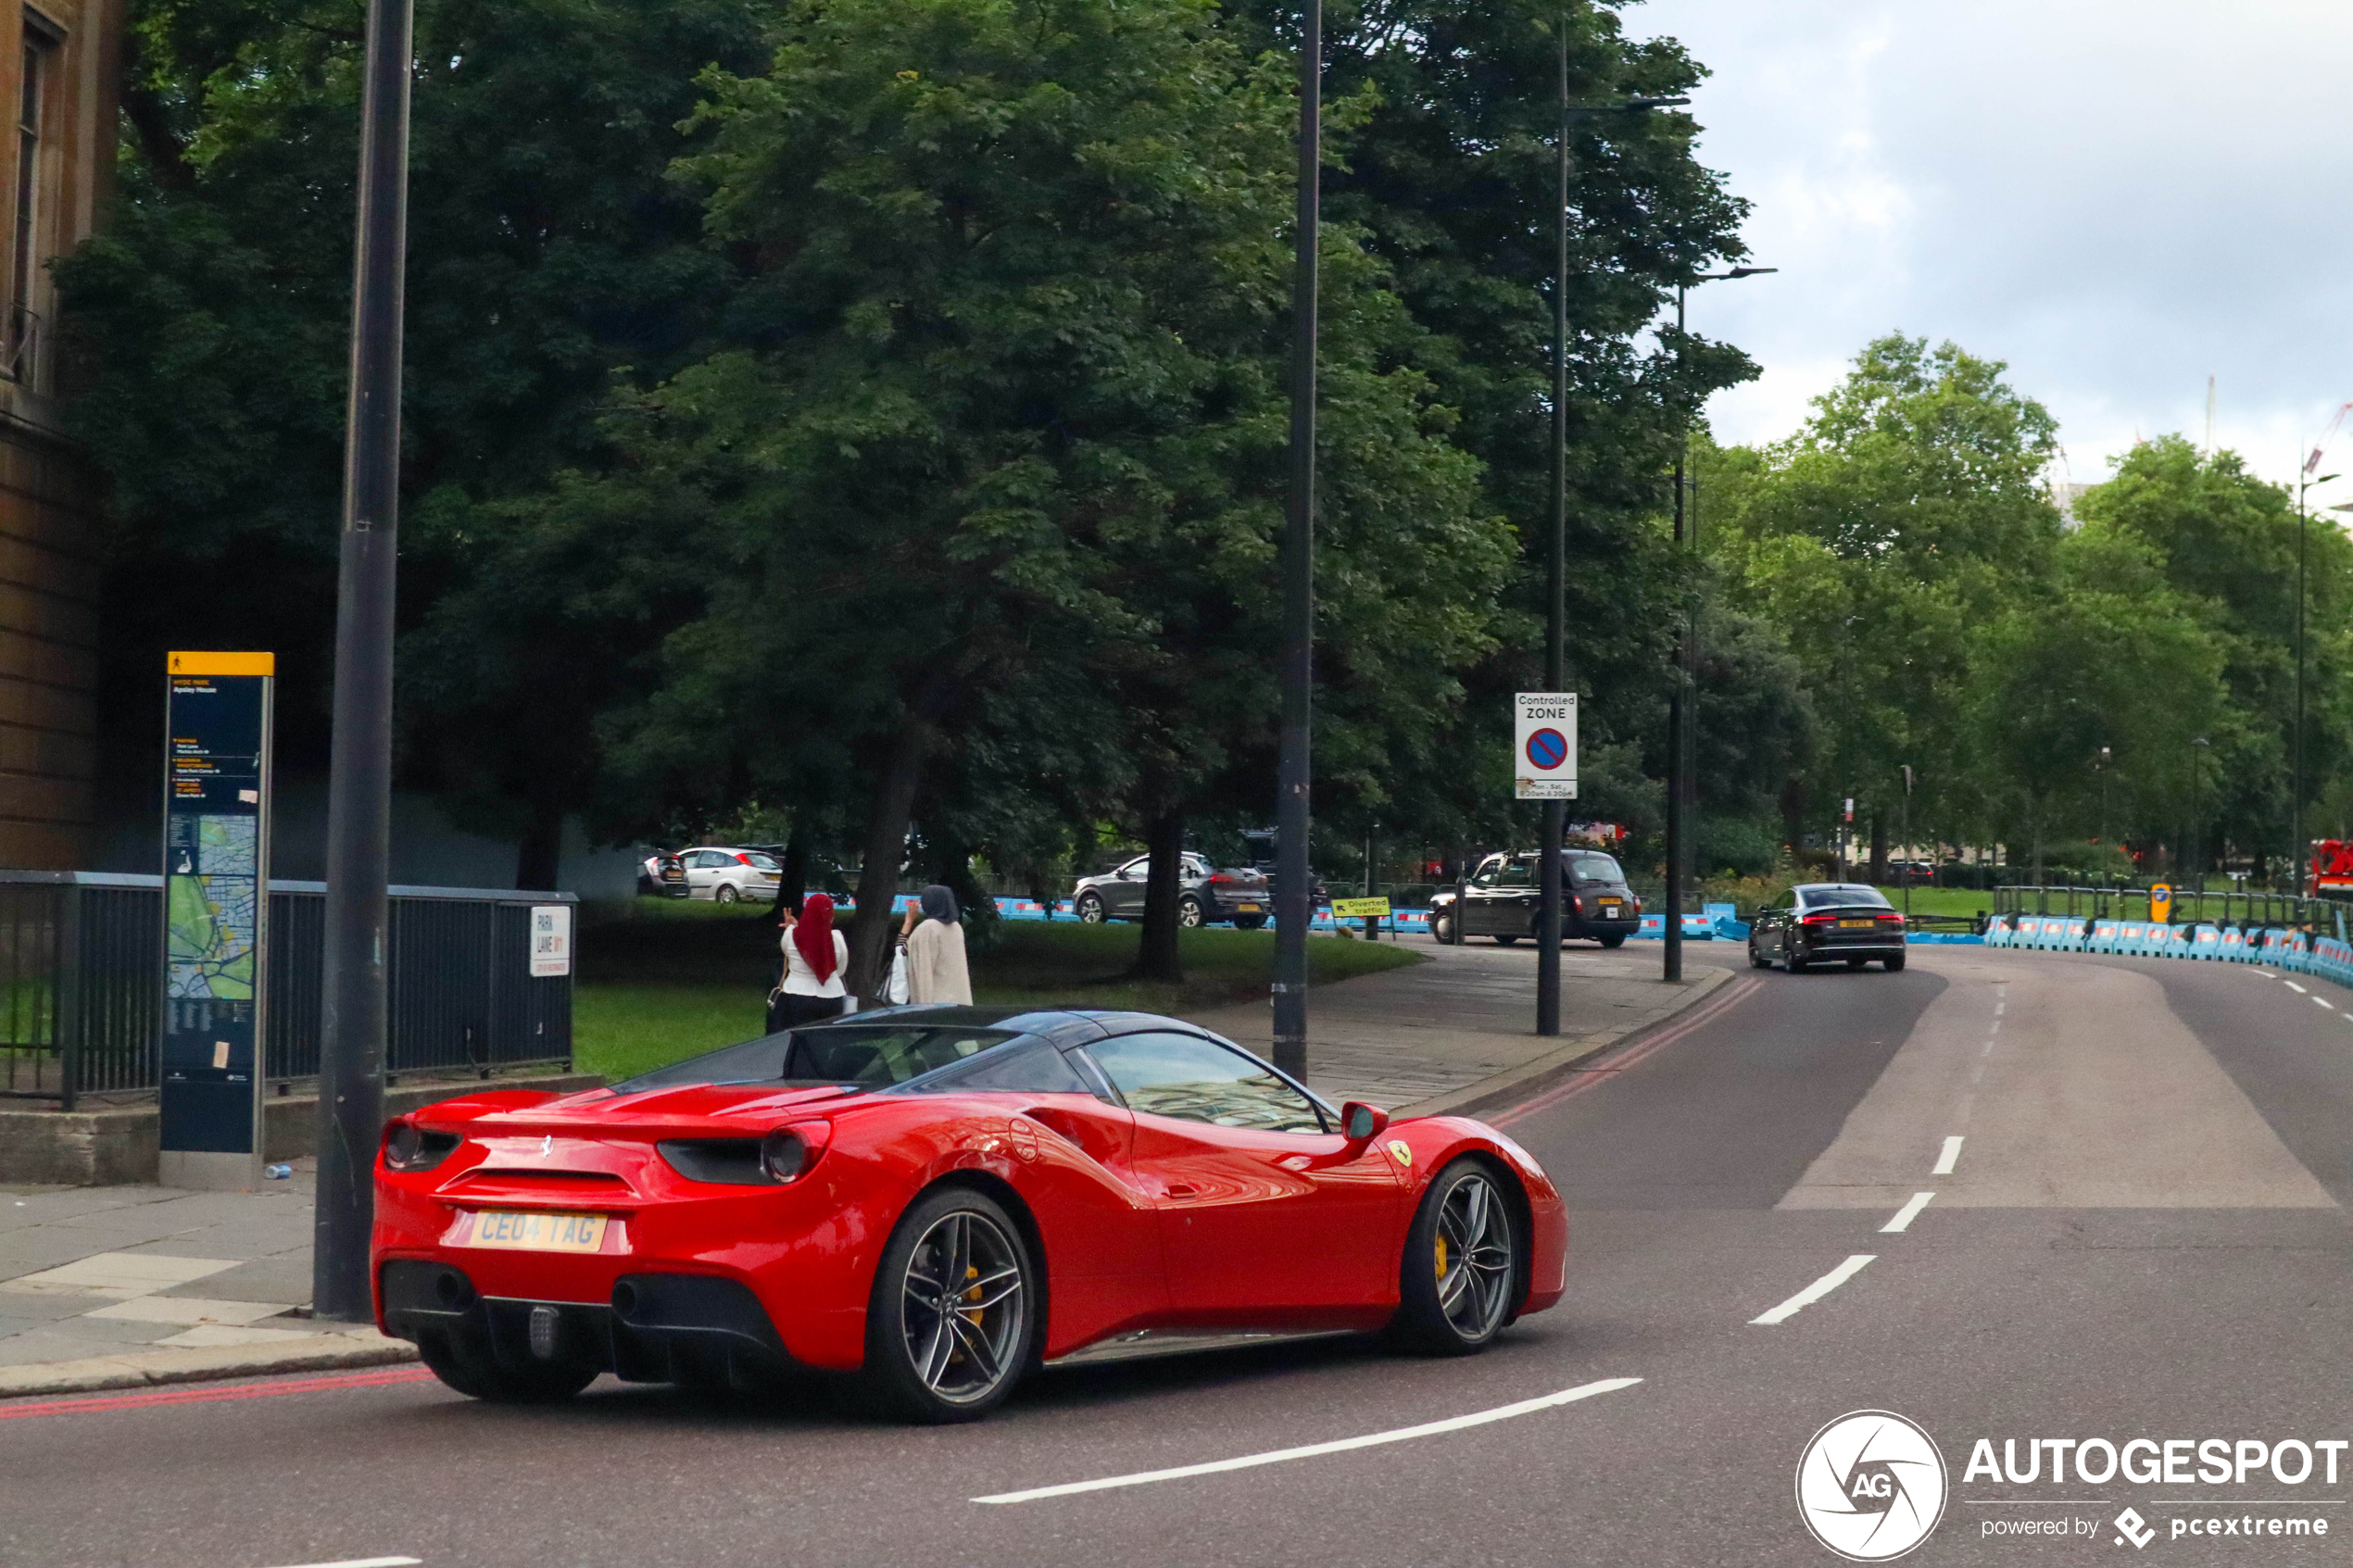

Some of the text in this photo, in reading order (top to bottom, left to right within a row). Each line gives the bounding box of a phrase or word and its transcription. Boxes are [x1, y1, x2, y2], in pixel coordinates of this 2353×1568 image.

[1518, 696, 1575, 705] Controlled
[1527, 708, 1567, 719] ZONE
[537, 915, 552, 931] PARK
[537, 936, 552, 952] LANE
[482, 1213, 597, 1244] CE04 TAG
